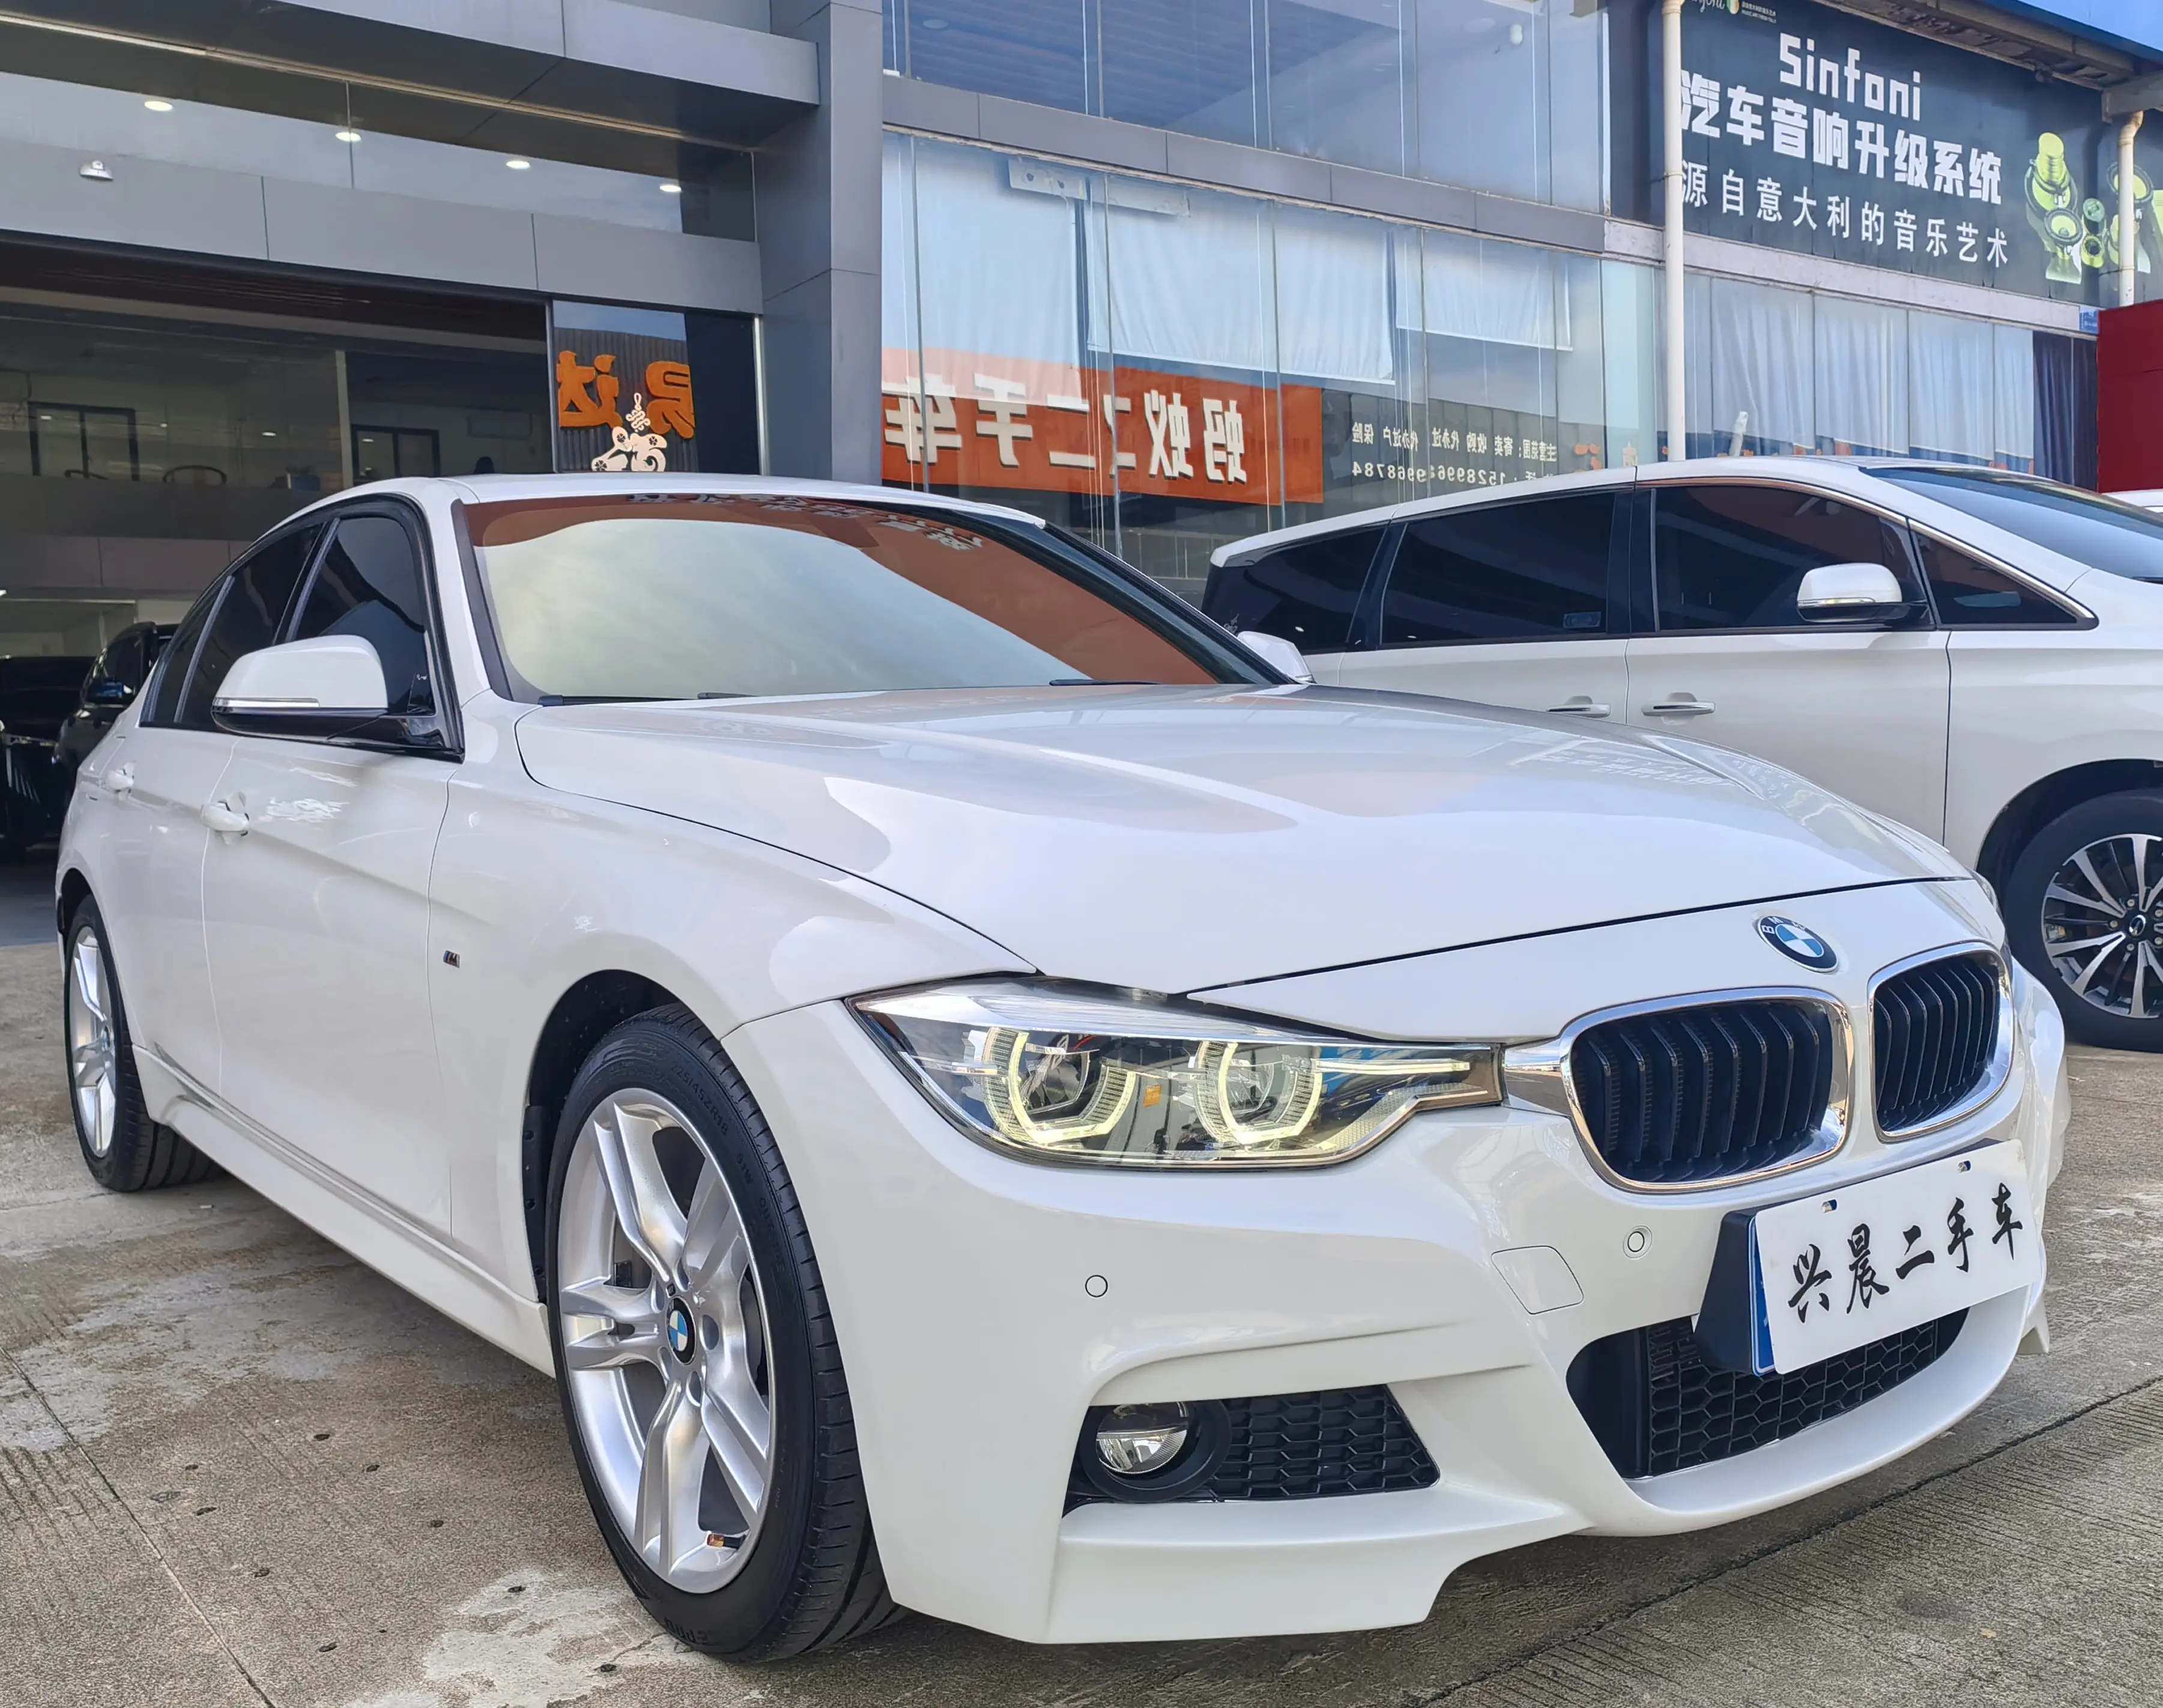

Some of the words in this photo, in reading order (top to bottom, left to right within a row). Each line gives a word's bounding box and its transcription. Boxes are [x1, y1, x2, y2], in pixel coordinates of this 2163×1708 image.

[1681, 69, 2002, 205] 汽车音响升级系统
[1779, 32, 1921, 121] Sinfoni
[1681, 159, 2009, 268] 源自意大利的音乐艺术
[1788, 1182, 2023, 1324] 兴晨二手车
